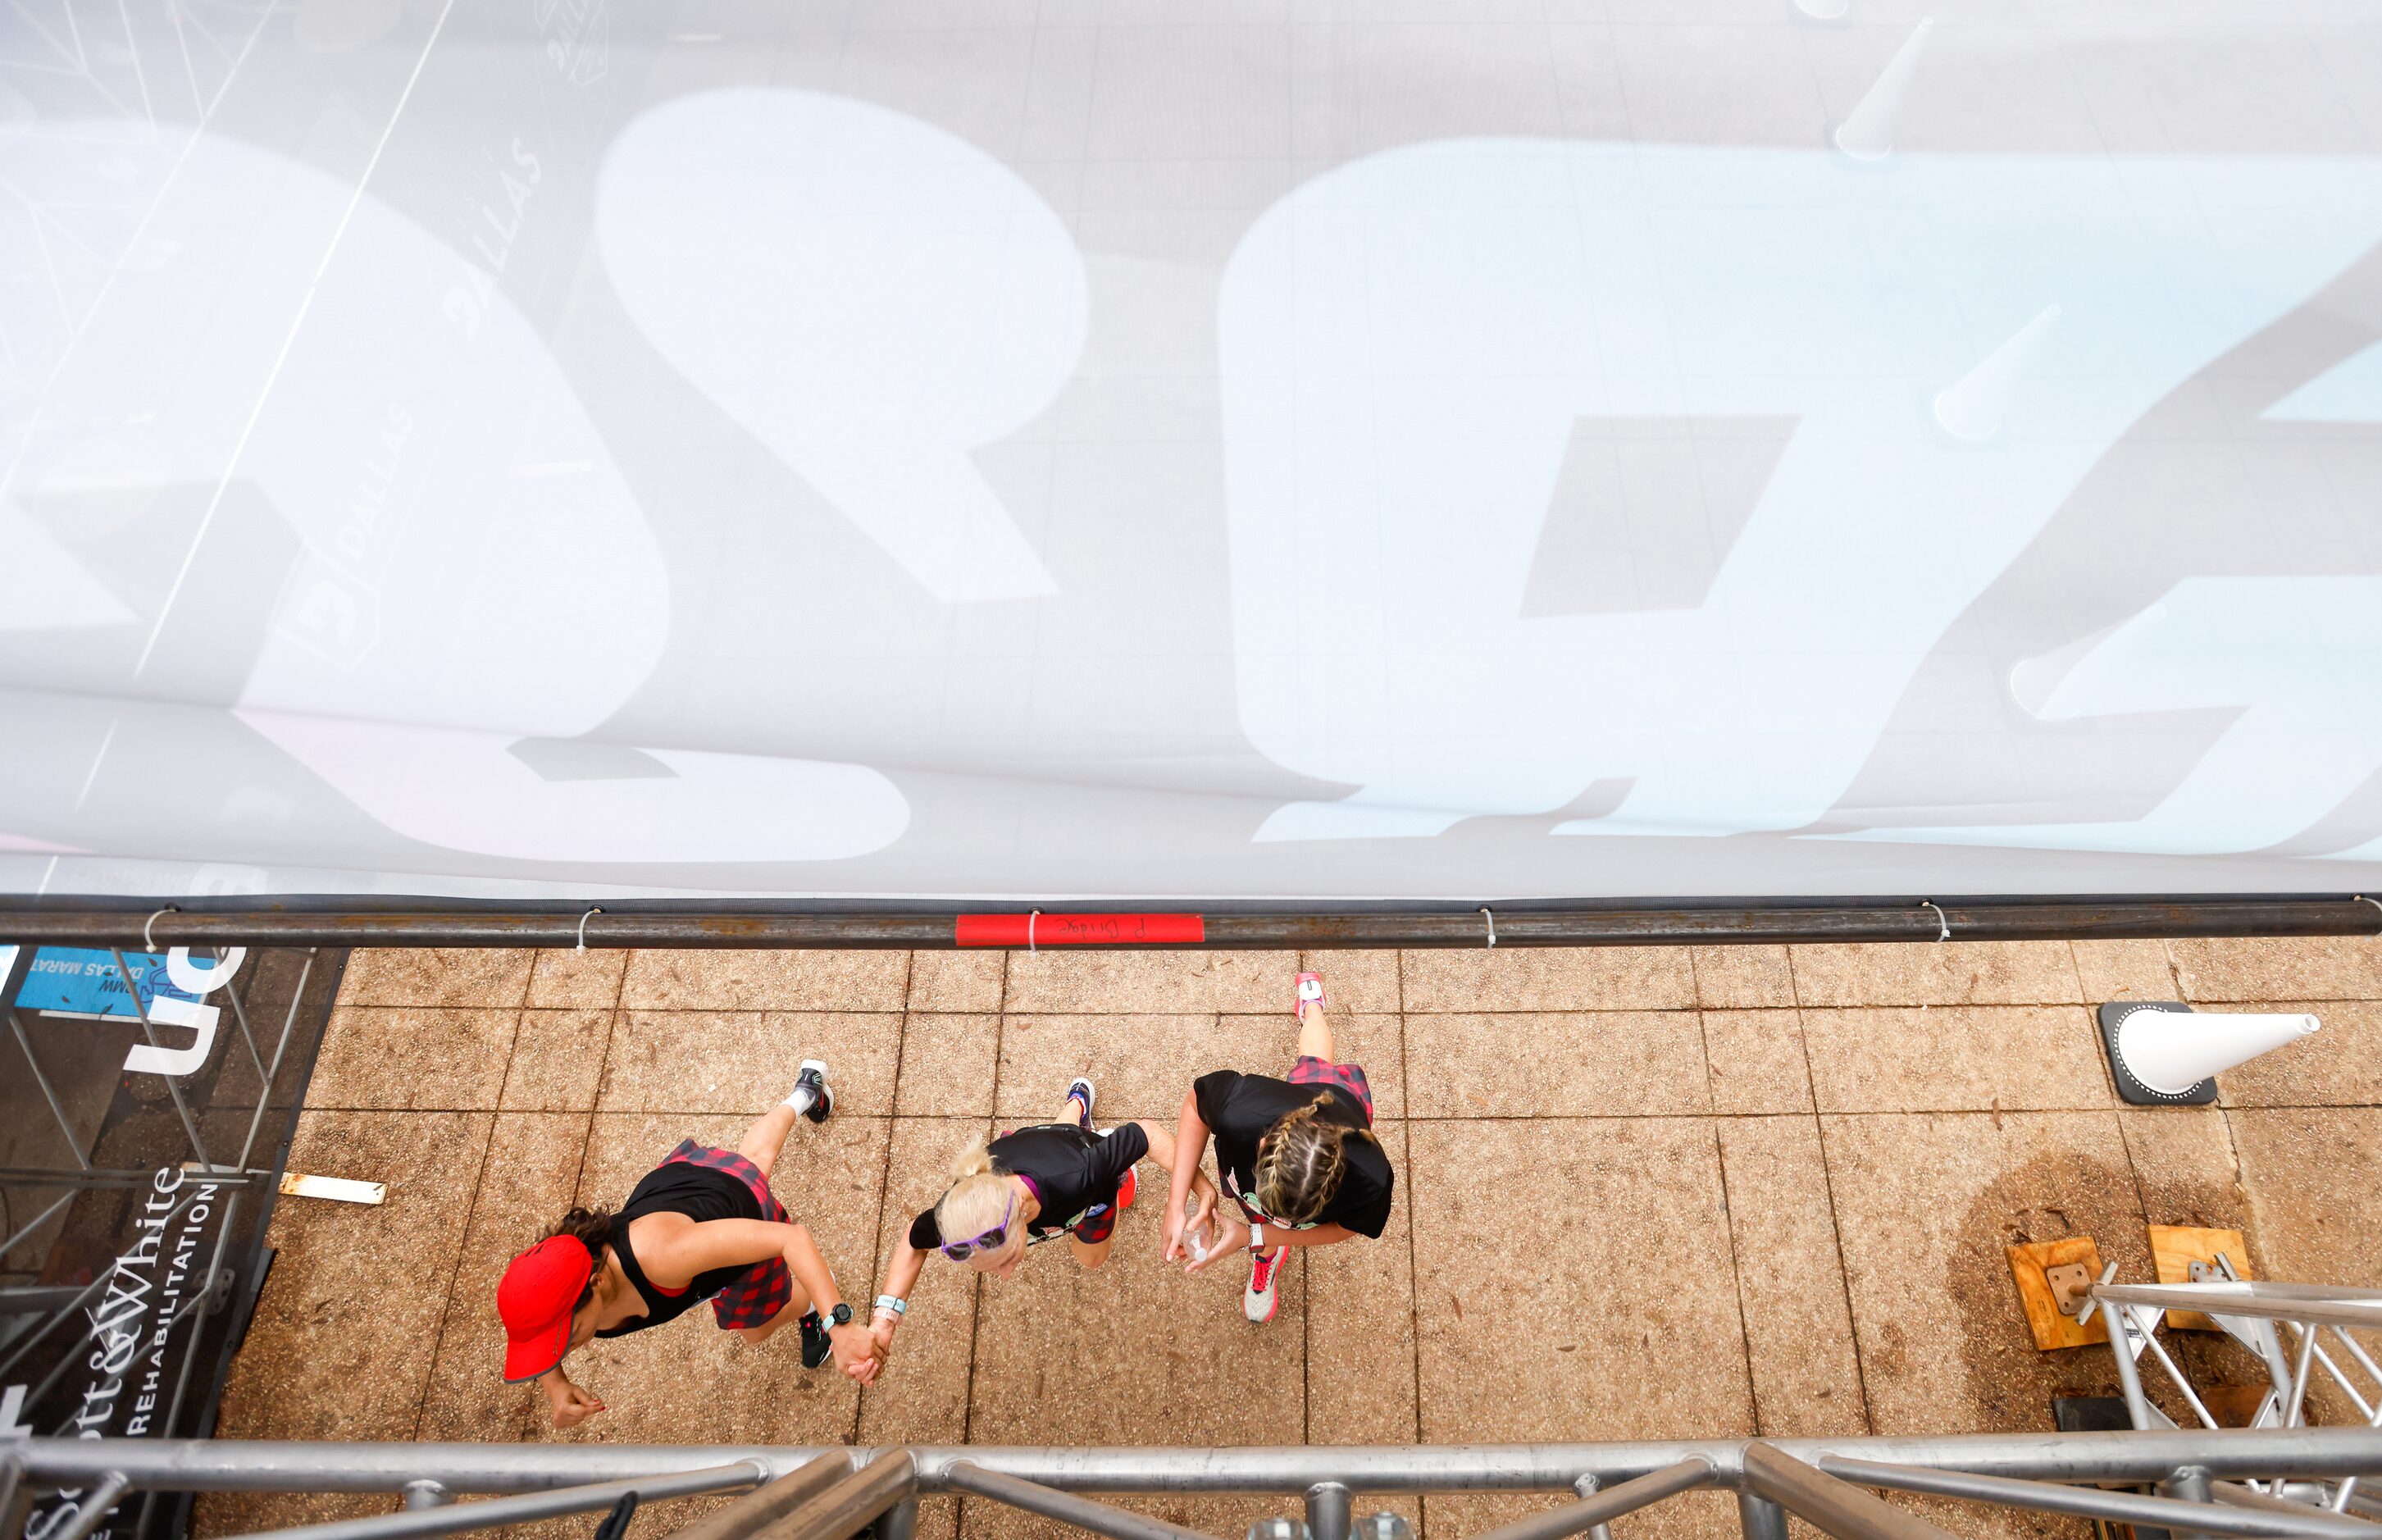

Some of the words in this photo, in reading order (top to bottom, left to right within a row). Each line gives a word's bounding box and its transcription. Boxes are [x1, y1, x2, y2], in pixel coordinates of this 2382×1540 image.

[335, 403, 414, 565] DALLAS
[1056, 918, 1119, 941] Bridge
[126, 1183, 219, 1436] REHABILITATION
